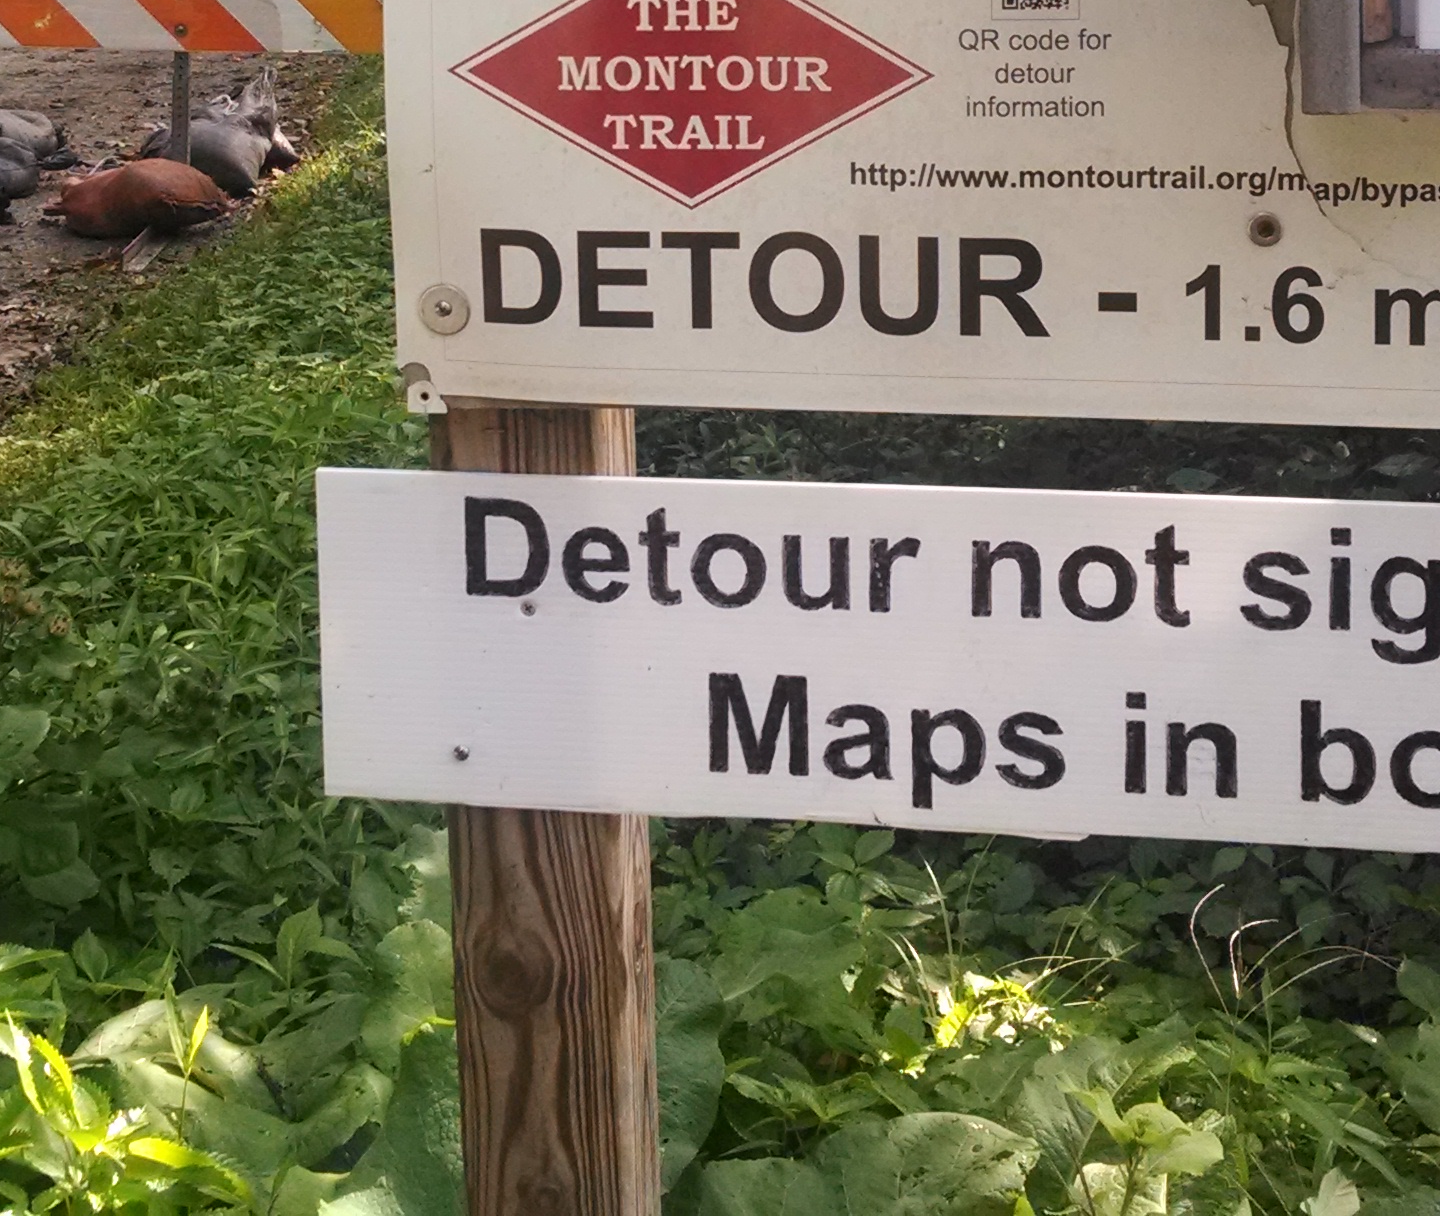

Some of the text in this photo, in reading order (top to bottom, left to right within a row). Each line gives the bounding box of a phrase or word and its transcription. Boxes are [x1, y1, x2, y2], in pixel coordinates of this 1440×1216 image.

[958, 28, 1113, 52] QR code for
[557, 54, 832, 92] MONTOUR
[995, 62, 1076, 84] detour
[965, 95, 1106, 118] information
[603, 114, 765, 151] TRAIL
[479, 228, 1051, 340] DETOUR
[1097, 290, 1138, 314] -
[1184, 263, 1325, 345] 1.6
[463, 496, 920, 614] Detour
[969, 525, 1193, 629] not
[706, 672, 1067, 810] Maps
[1124, 691, 1239, 800] in
